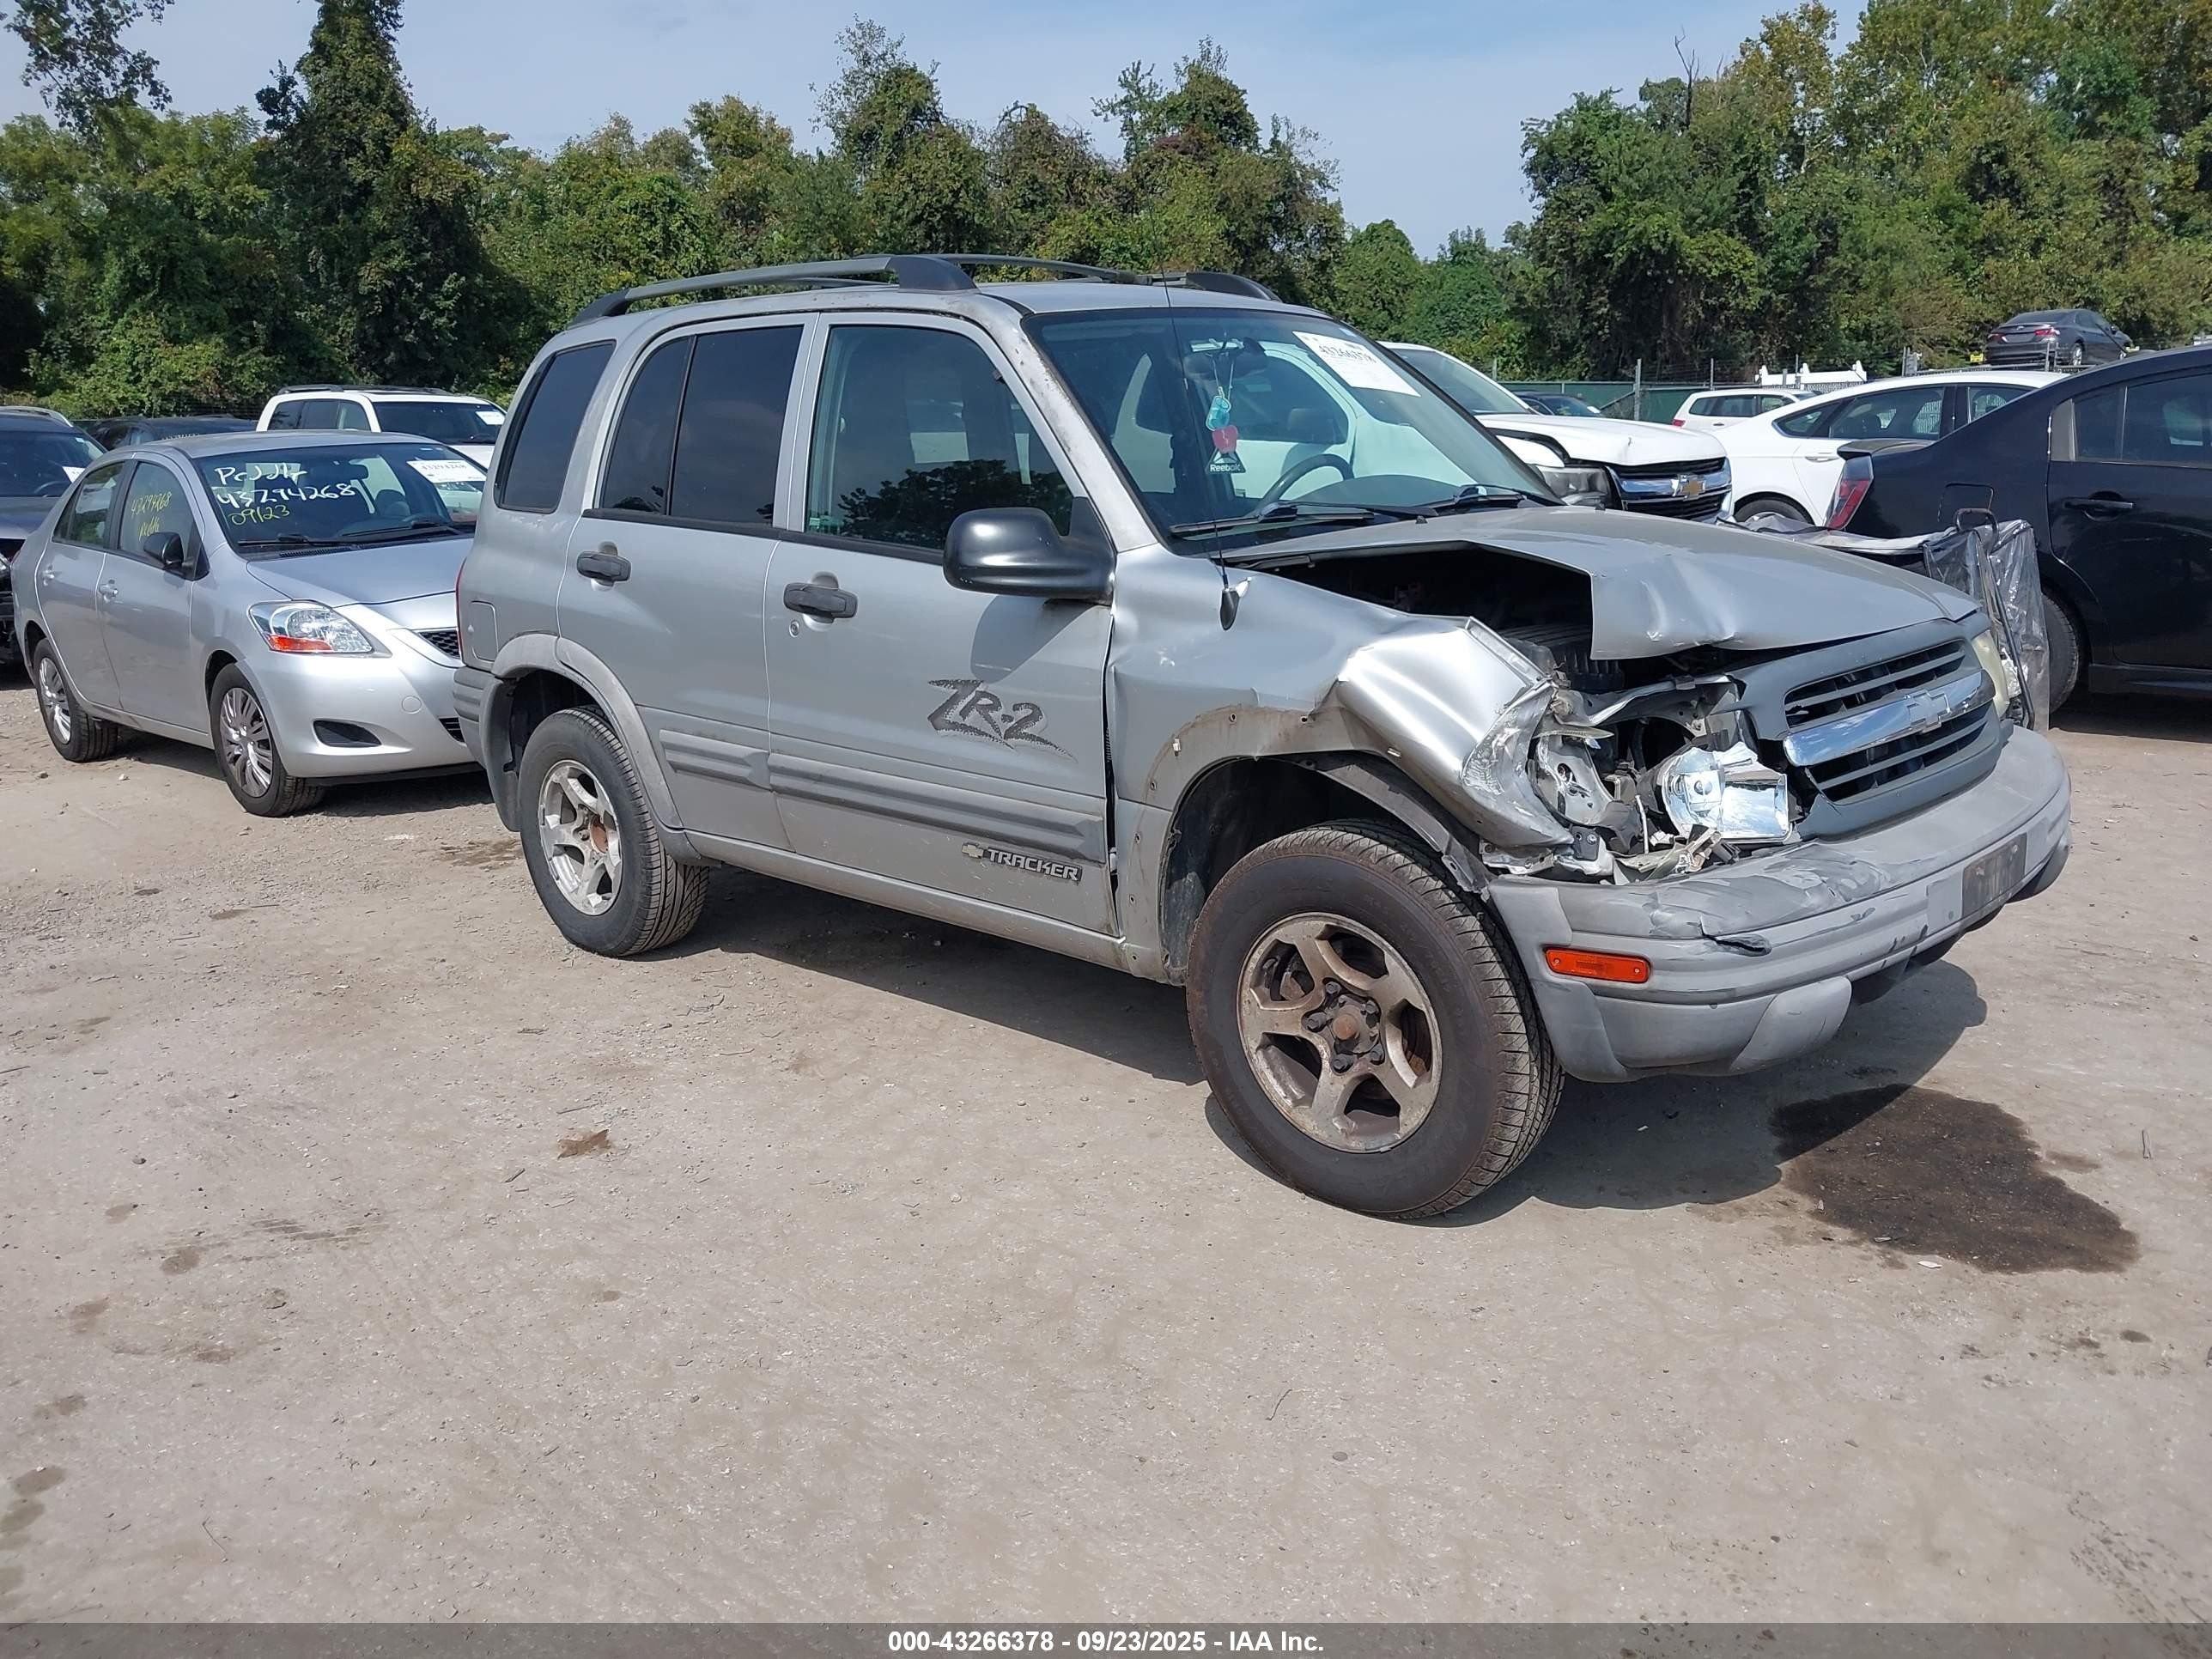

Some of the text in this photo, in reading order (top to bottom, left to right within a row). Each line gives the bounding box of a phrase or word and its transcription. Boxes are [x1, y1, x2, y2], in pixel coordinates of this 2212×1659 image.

[1209, 464, 1241, 472] Reebok
[216, 483, 356, 508] 43294268
[927, 679, 1077, 763] ZR-2
[988, 848, 1079, 882] TRACKER
